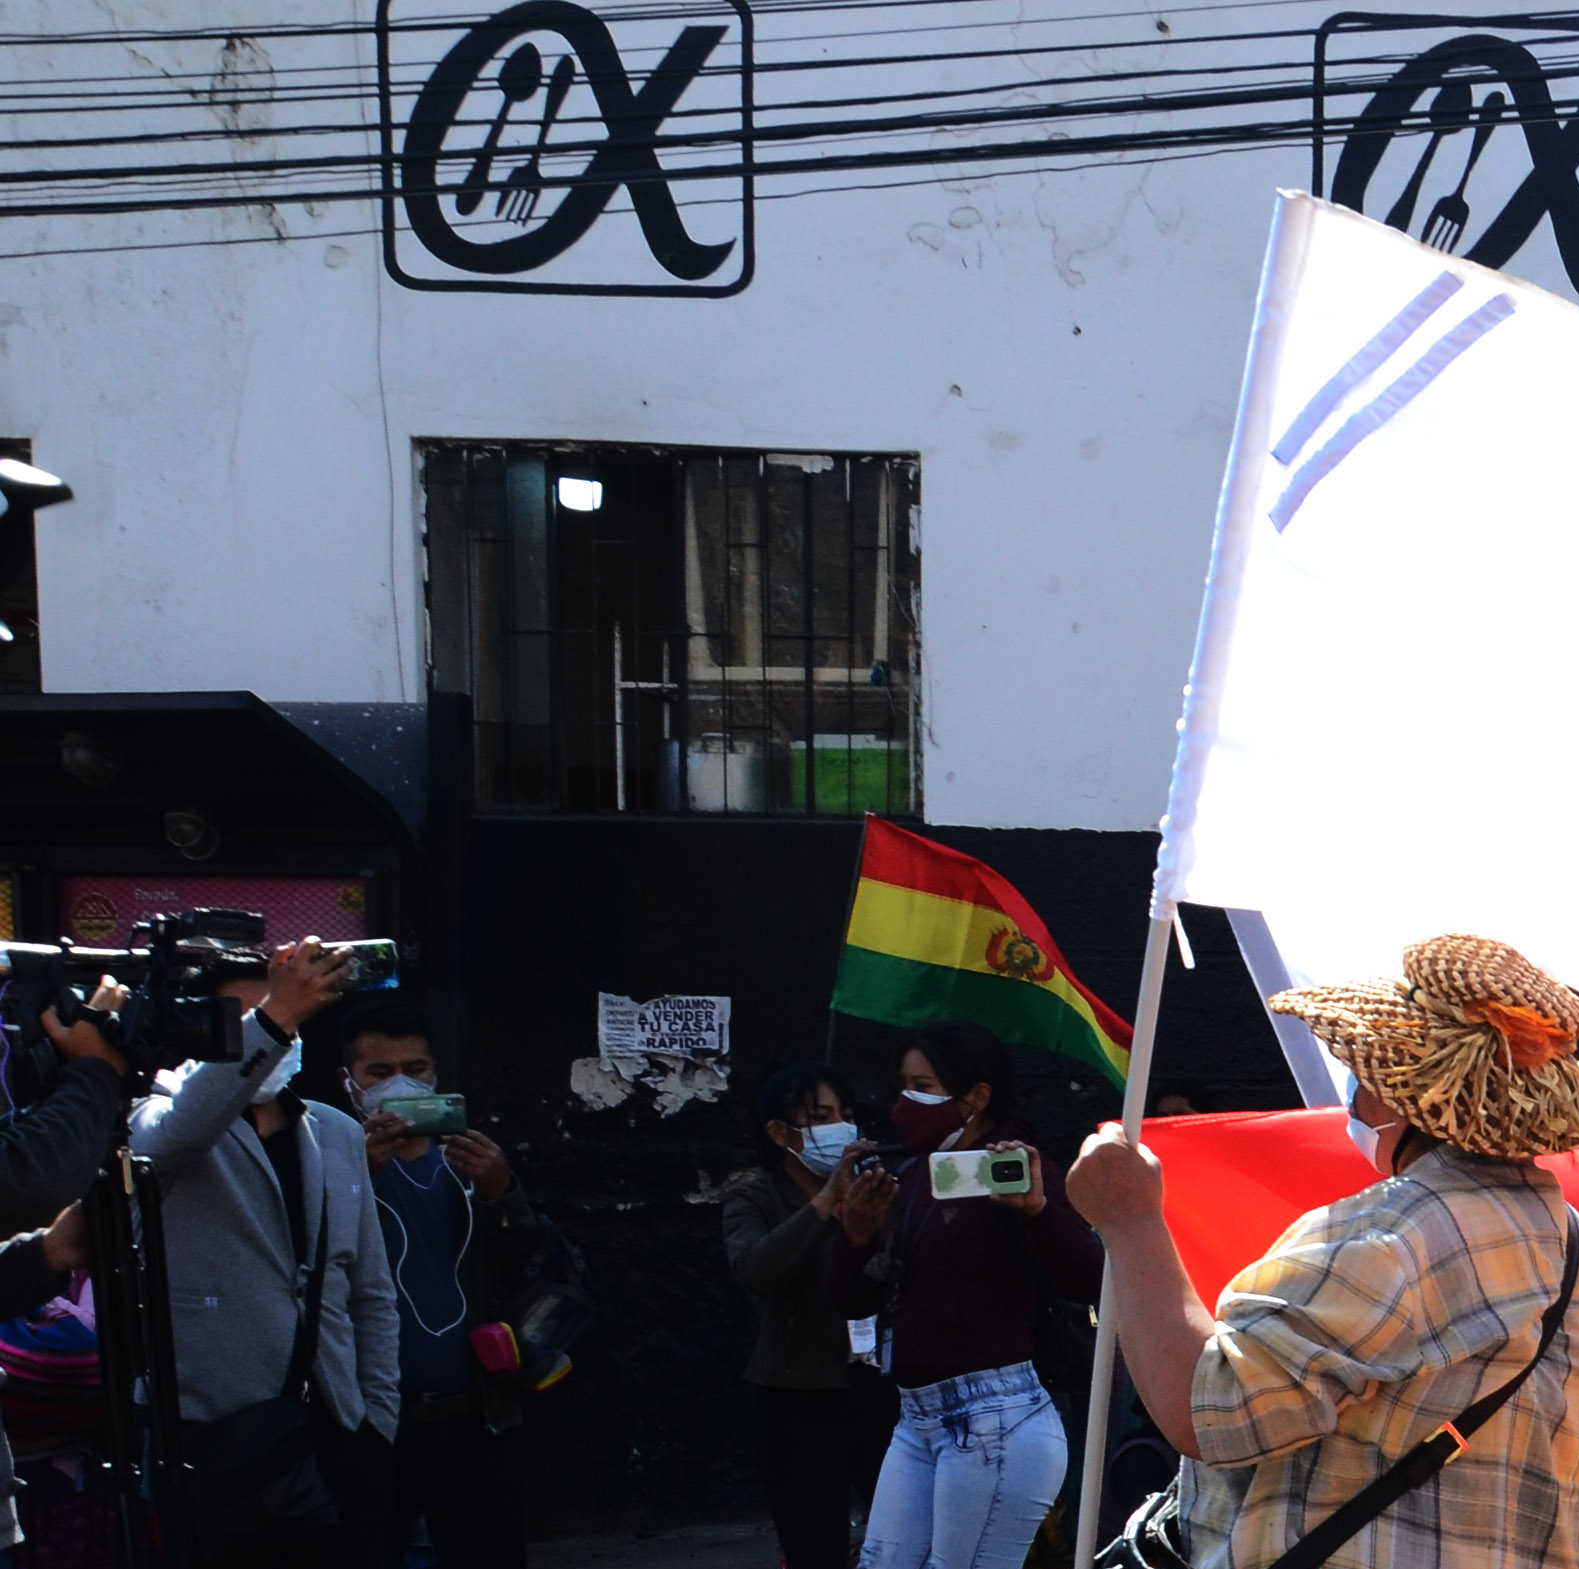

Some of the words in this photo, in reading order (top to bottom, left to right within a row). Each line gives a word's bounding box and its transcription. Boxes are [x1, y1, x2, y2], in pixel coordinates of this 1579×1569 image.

[654, 998, 717, 1010] AYUDAMOS
[653, 1011, 714, 1021] VENDER
[640, 1022, 661, 1032] TU
[669, 1021, 716, 1032] CASA
